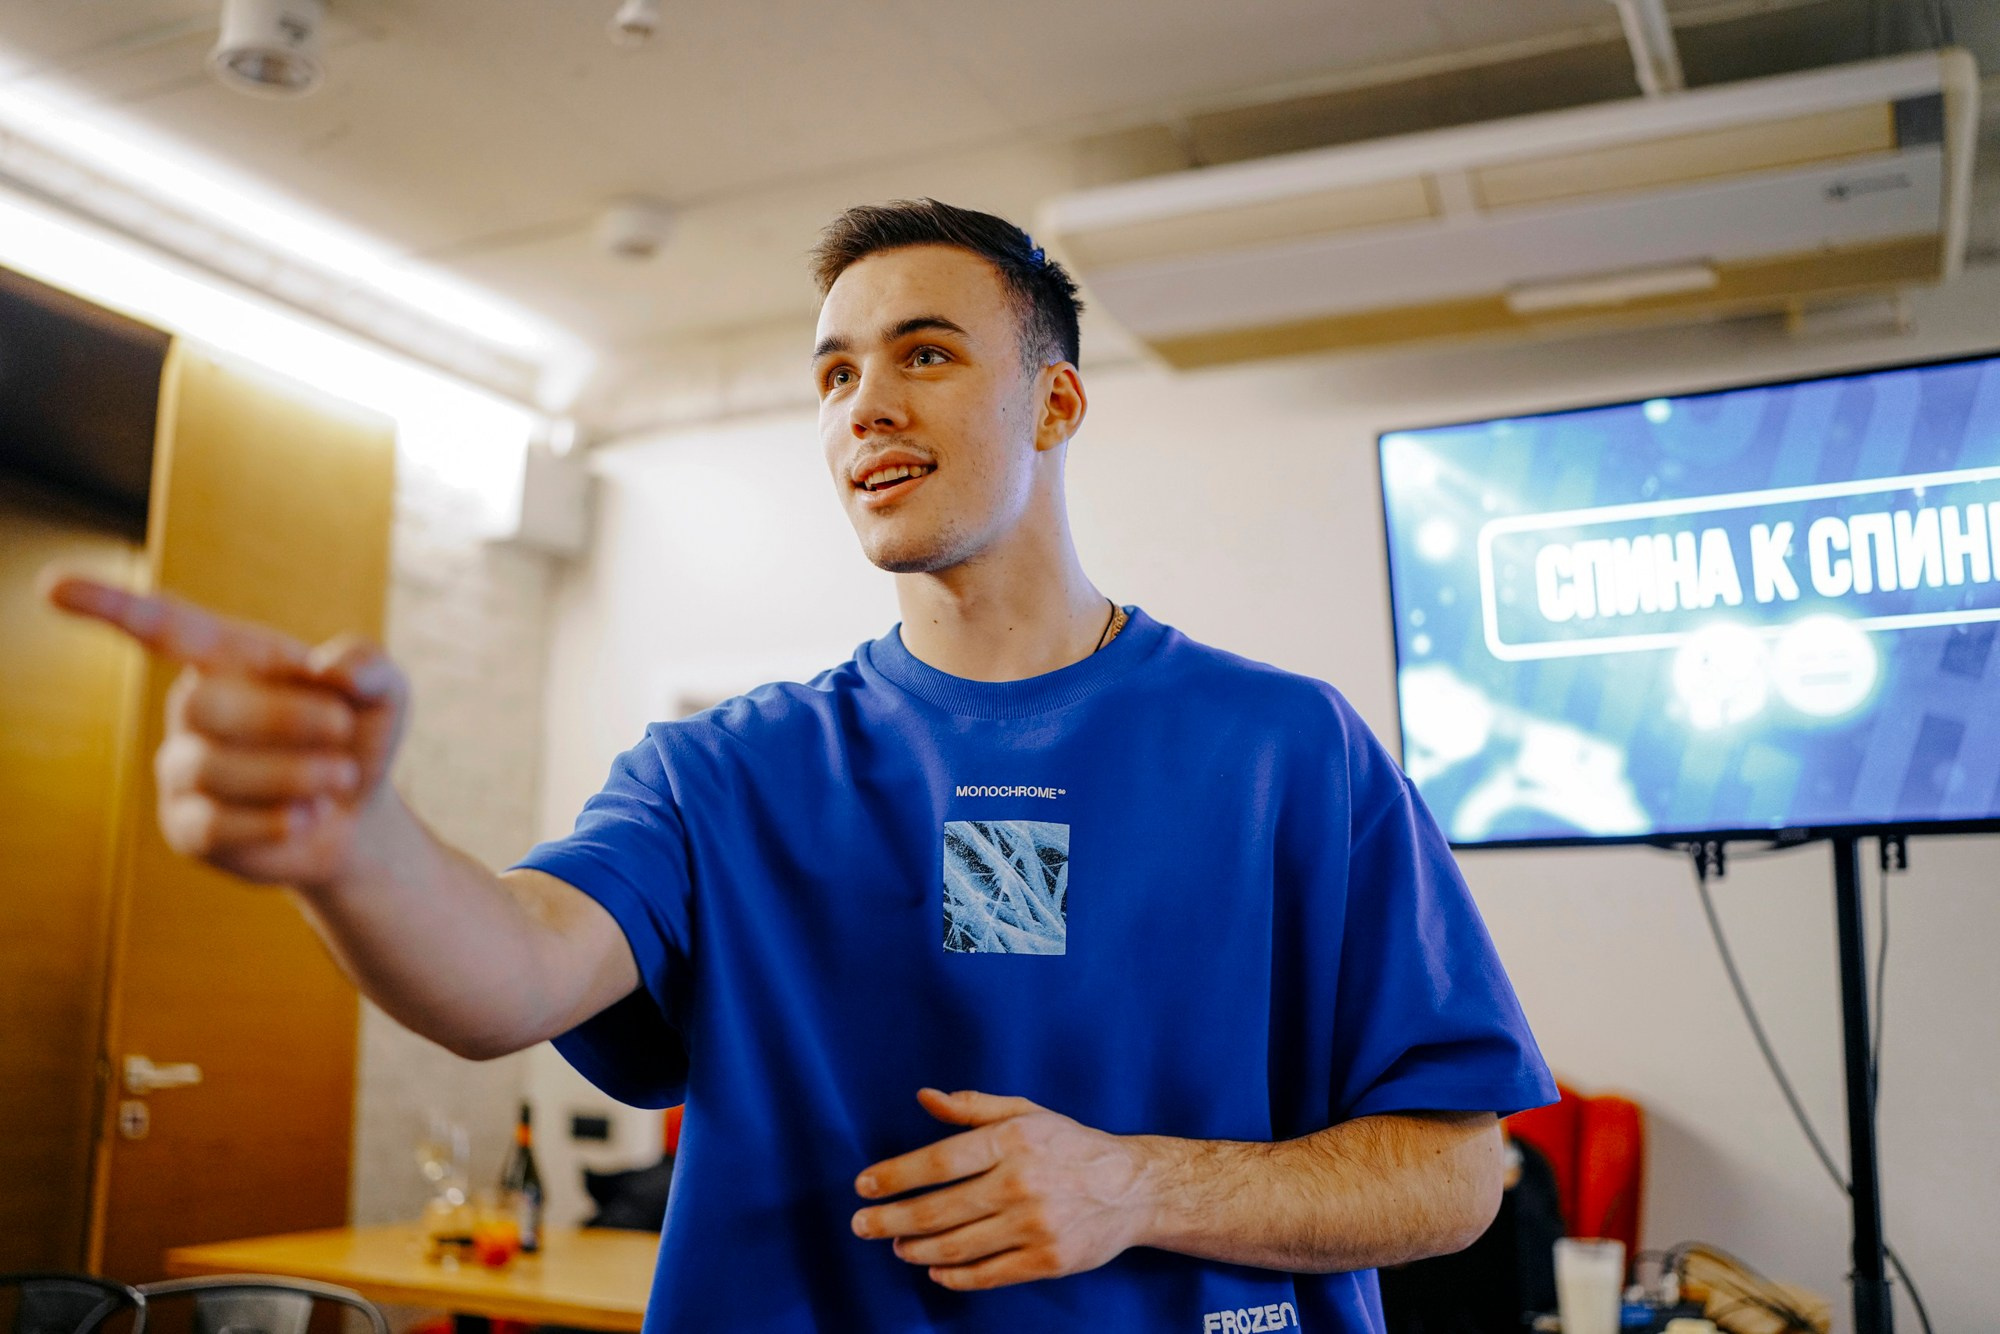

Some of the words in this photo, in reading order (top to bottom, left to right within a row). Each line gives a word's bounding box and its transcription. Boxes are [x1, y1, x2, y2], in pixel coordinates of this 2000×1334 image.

[1535, 527, 1743, 622] СПИНА
[1749, 521, 1799, 603] К
[956, 785, 1057, 799] MONOCHROME
[1203, 1302, 1297, 1334] FROZEN
